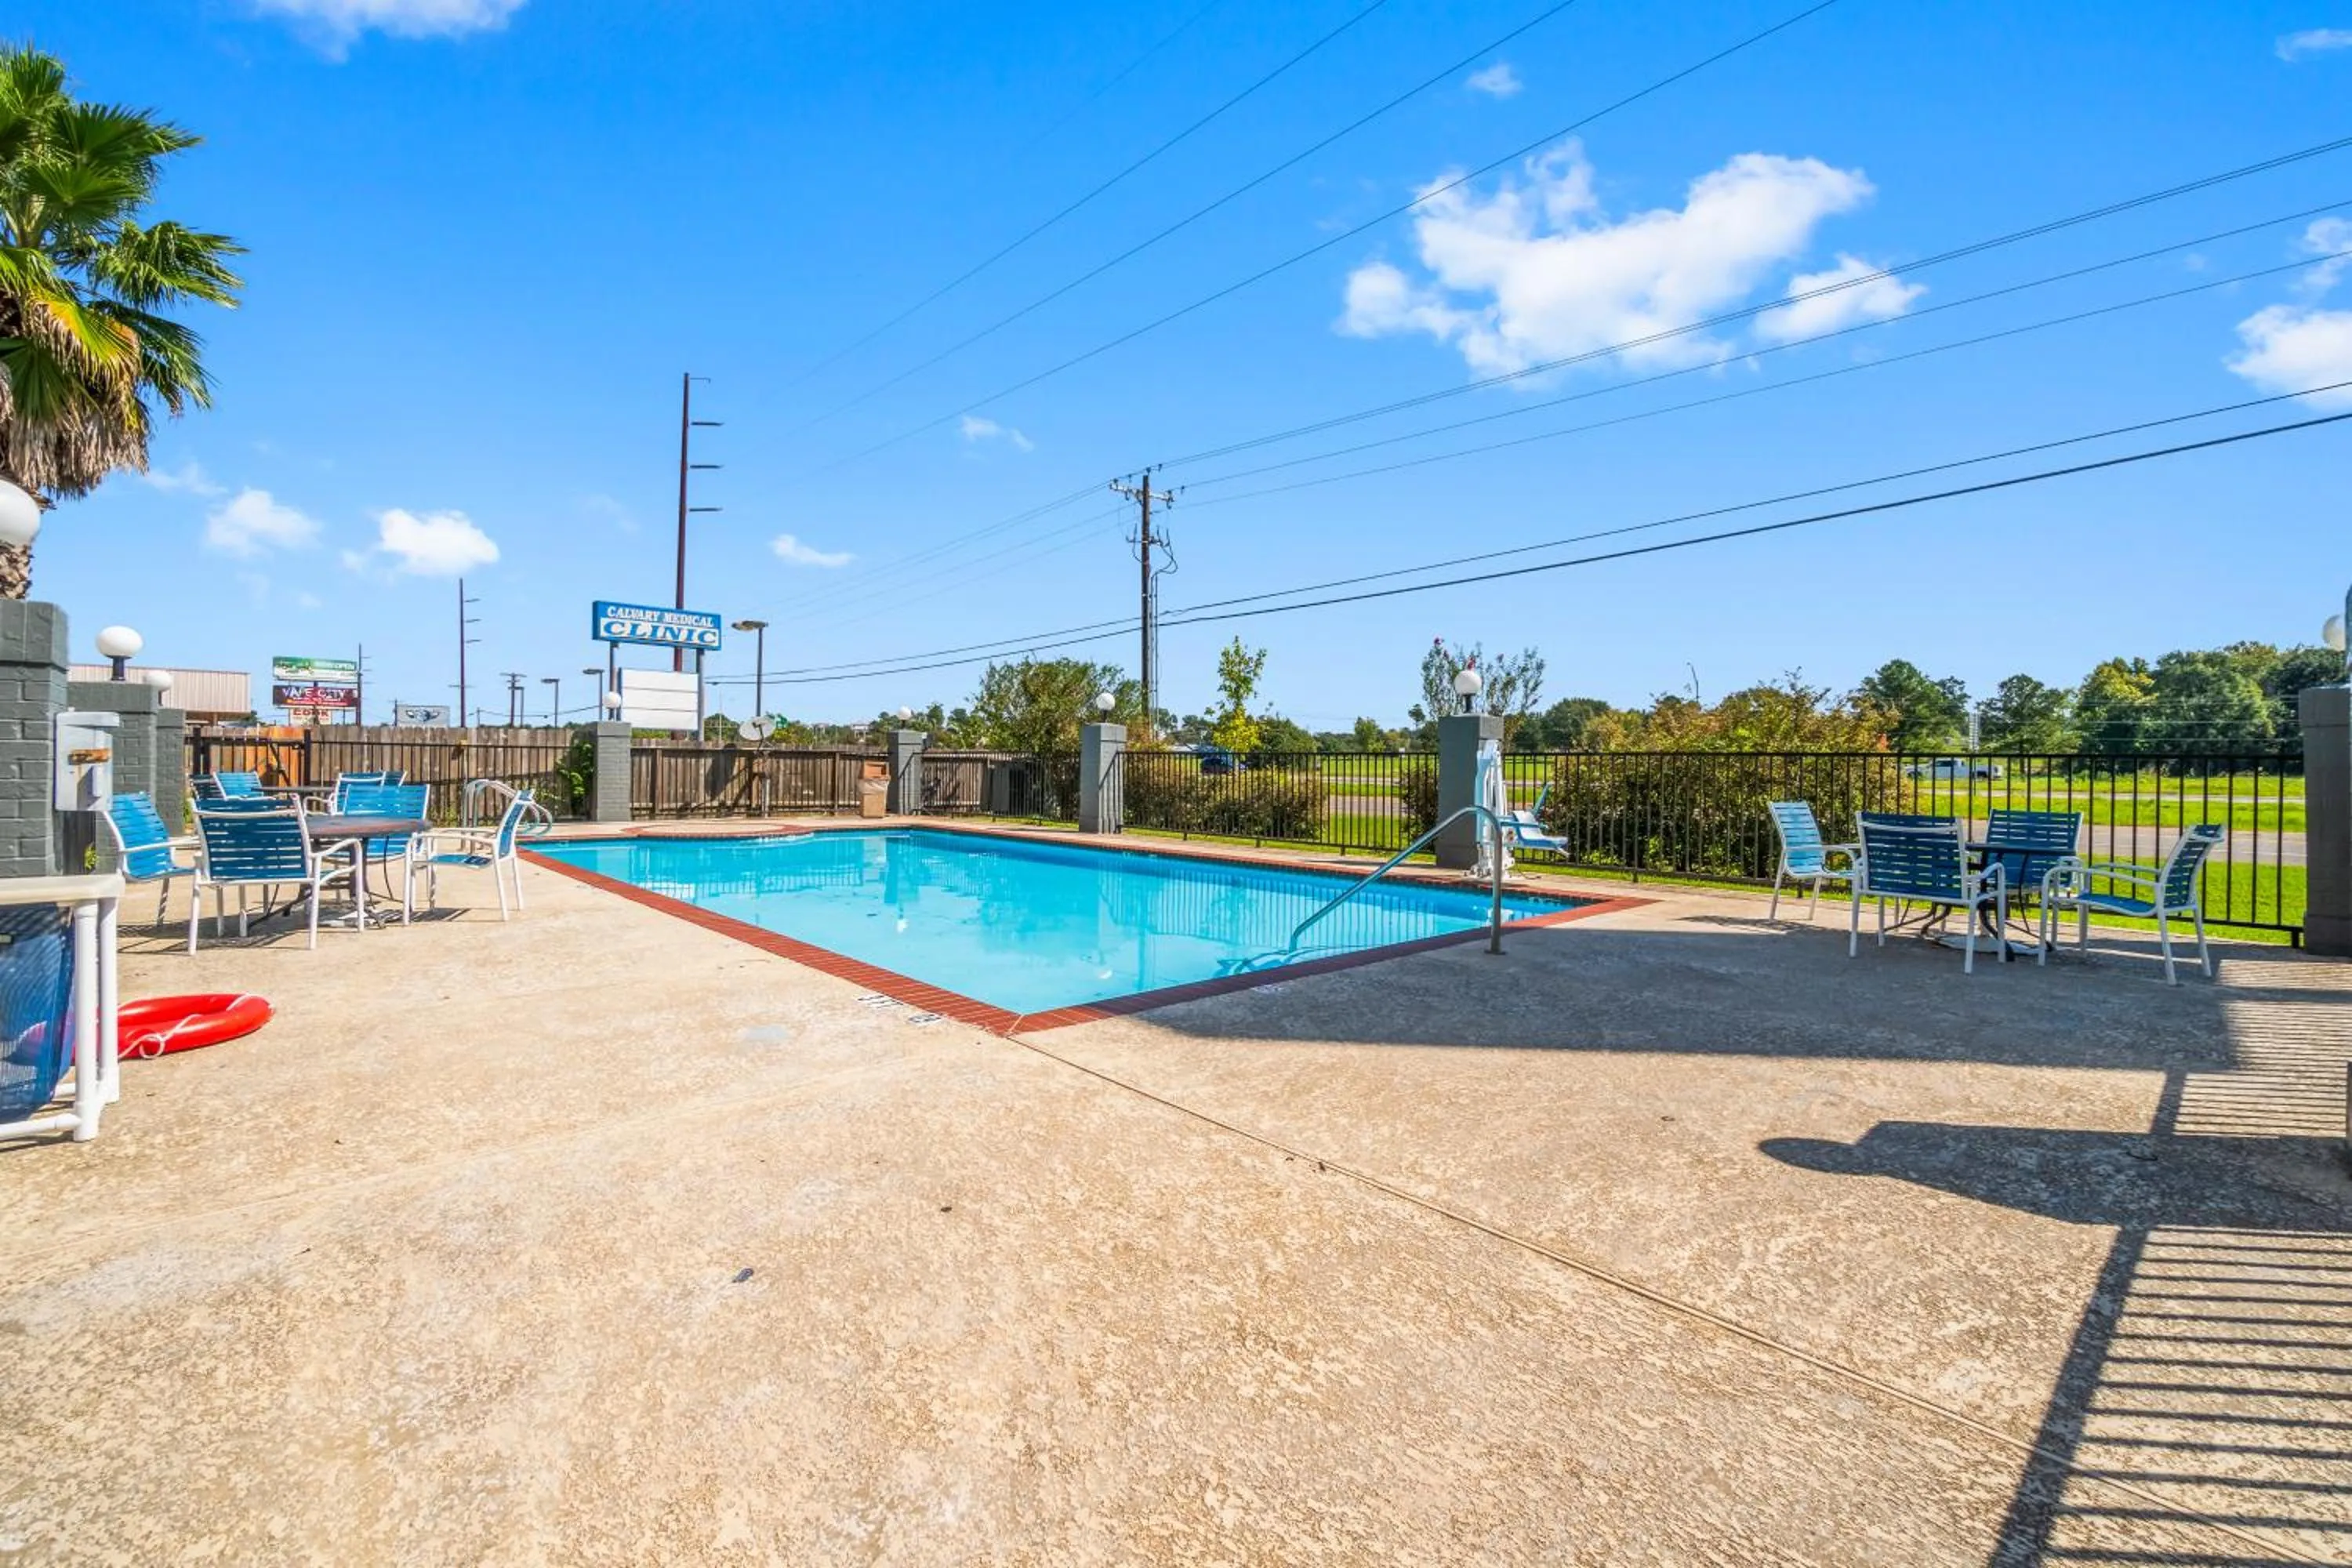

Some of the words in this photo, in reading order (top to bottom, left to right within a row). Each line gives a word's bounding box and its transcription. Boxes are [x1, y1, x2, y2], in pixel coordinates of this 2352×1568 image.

[607, 606, 660, 622] CALVARY
[664, 612, 714, 627] MEDICAL
[604, 621, 717, 644] CLINIC
